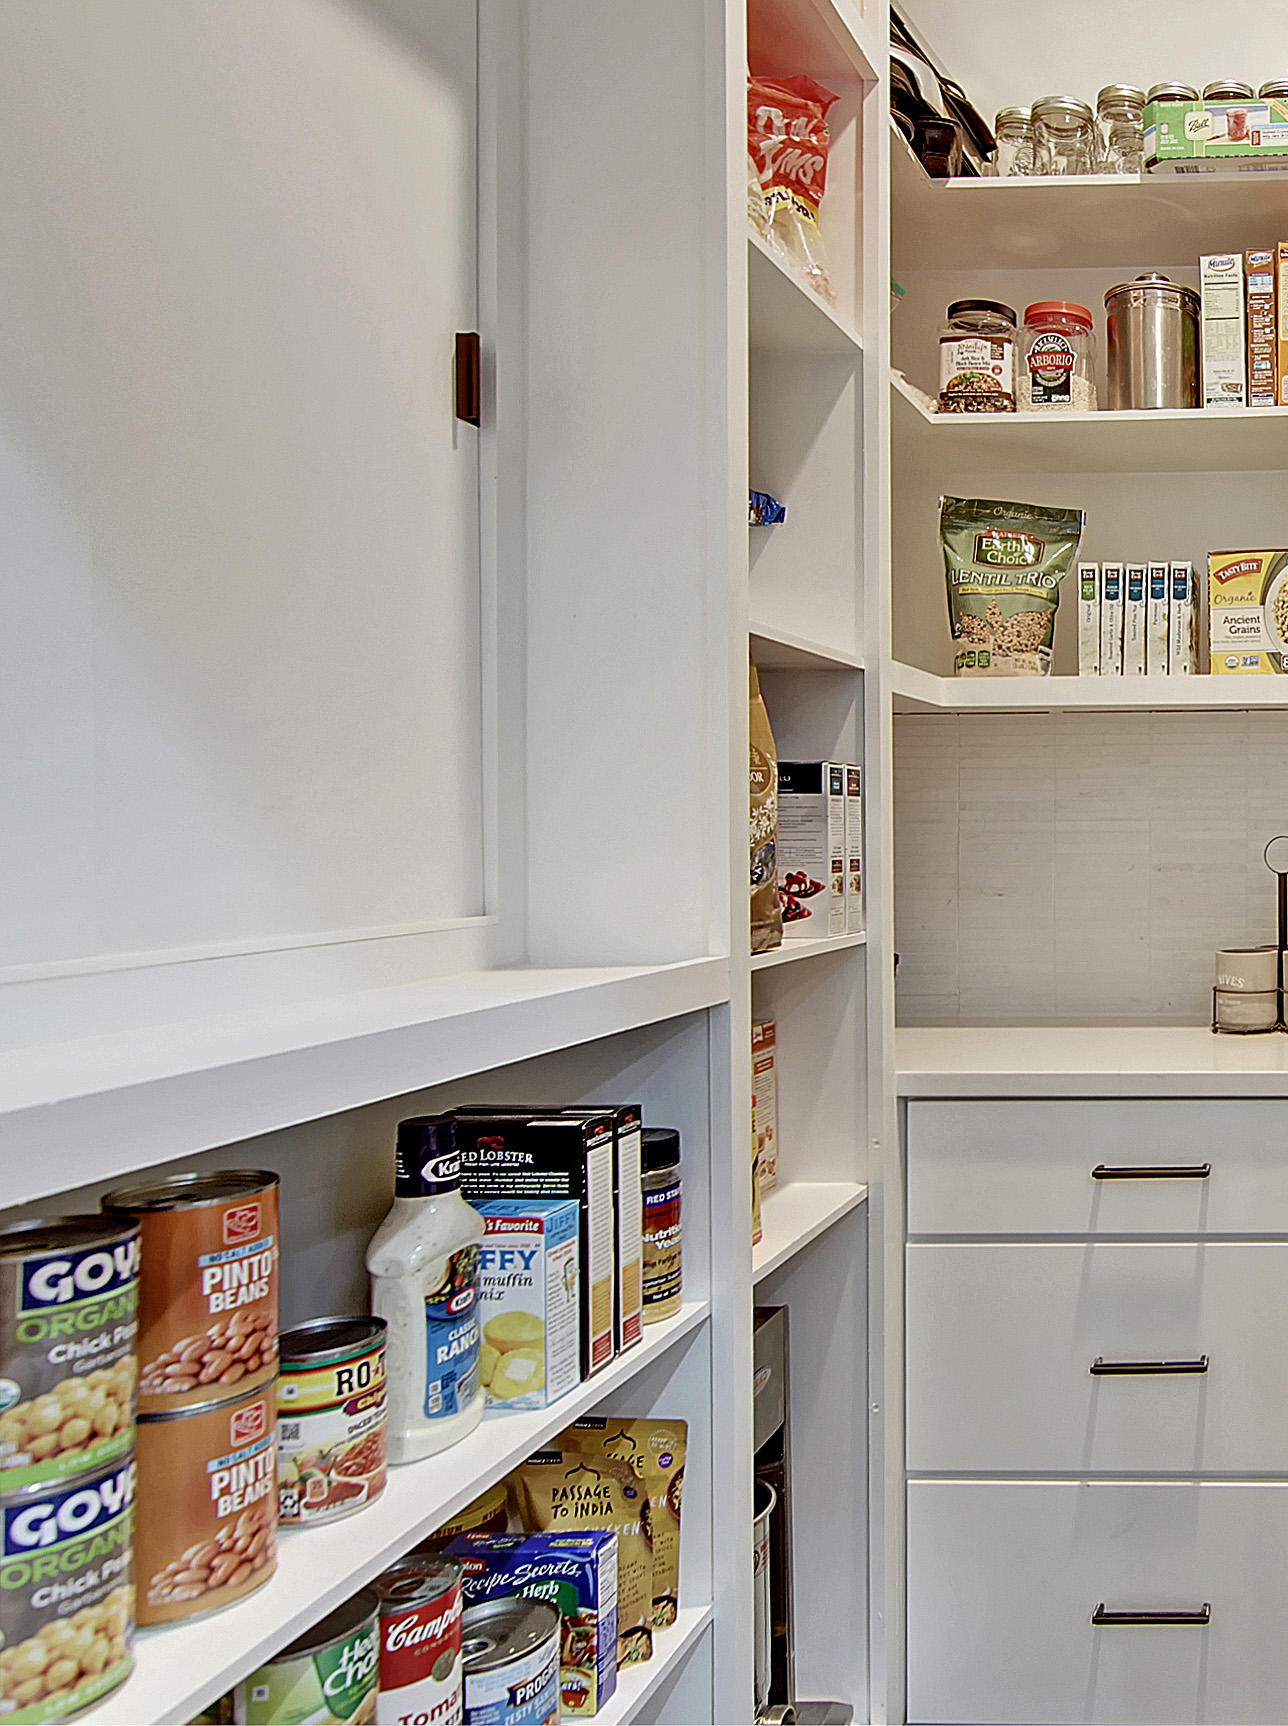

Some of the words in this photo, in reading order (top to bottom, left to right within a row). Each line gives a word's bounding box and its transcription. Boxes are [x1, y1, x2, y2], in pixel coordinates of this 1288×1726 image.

[1188, 119, 1210, 132] Ball
[1029, 354, 1073, 368] ARBORIO
[951, 569, 1011, 586] LENTIL
[1016, 572, 1056, 588] TRIO
[1218, 563, 1241, 580] TASTY
[1240, 561, 1258, 571] BITE
[1214, 591, 1256, 605] Organic
[1223, 615, 1261, 625] Ancient
[1229, 625, 1261, 634] Grains
[480, 1149, 534, 1164] LOBSTER
[646, 1193, 664, 1205] RED
[494, 1219, 539, 1232] Favorite
[480, 1249, 538, 1271] FFY
[203, 1249, 273, 1296] PINTO
[483, 1274, 533, 1287] muffin
[209, 1280, 270, 1314] BEANS
[48, 1331, 112, 1364] Chick
[211, 1446, 274, 1500] PINTO
[217, 1480, 272, 1519] BEANS
[552, 1485, 611, 1501] PASSAGE
[461, 1572, 516, 1599] Recipe
[513, 1559, 581, 1586] Secrets
[31, 1569, 101, 1610] Chick
[522, 1580, 559, 1600] Herb
